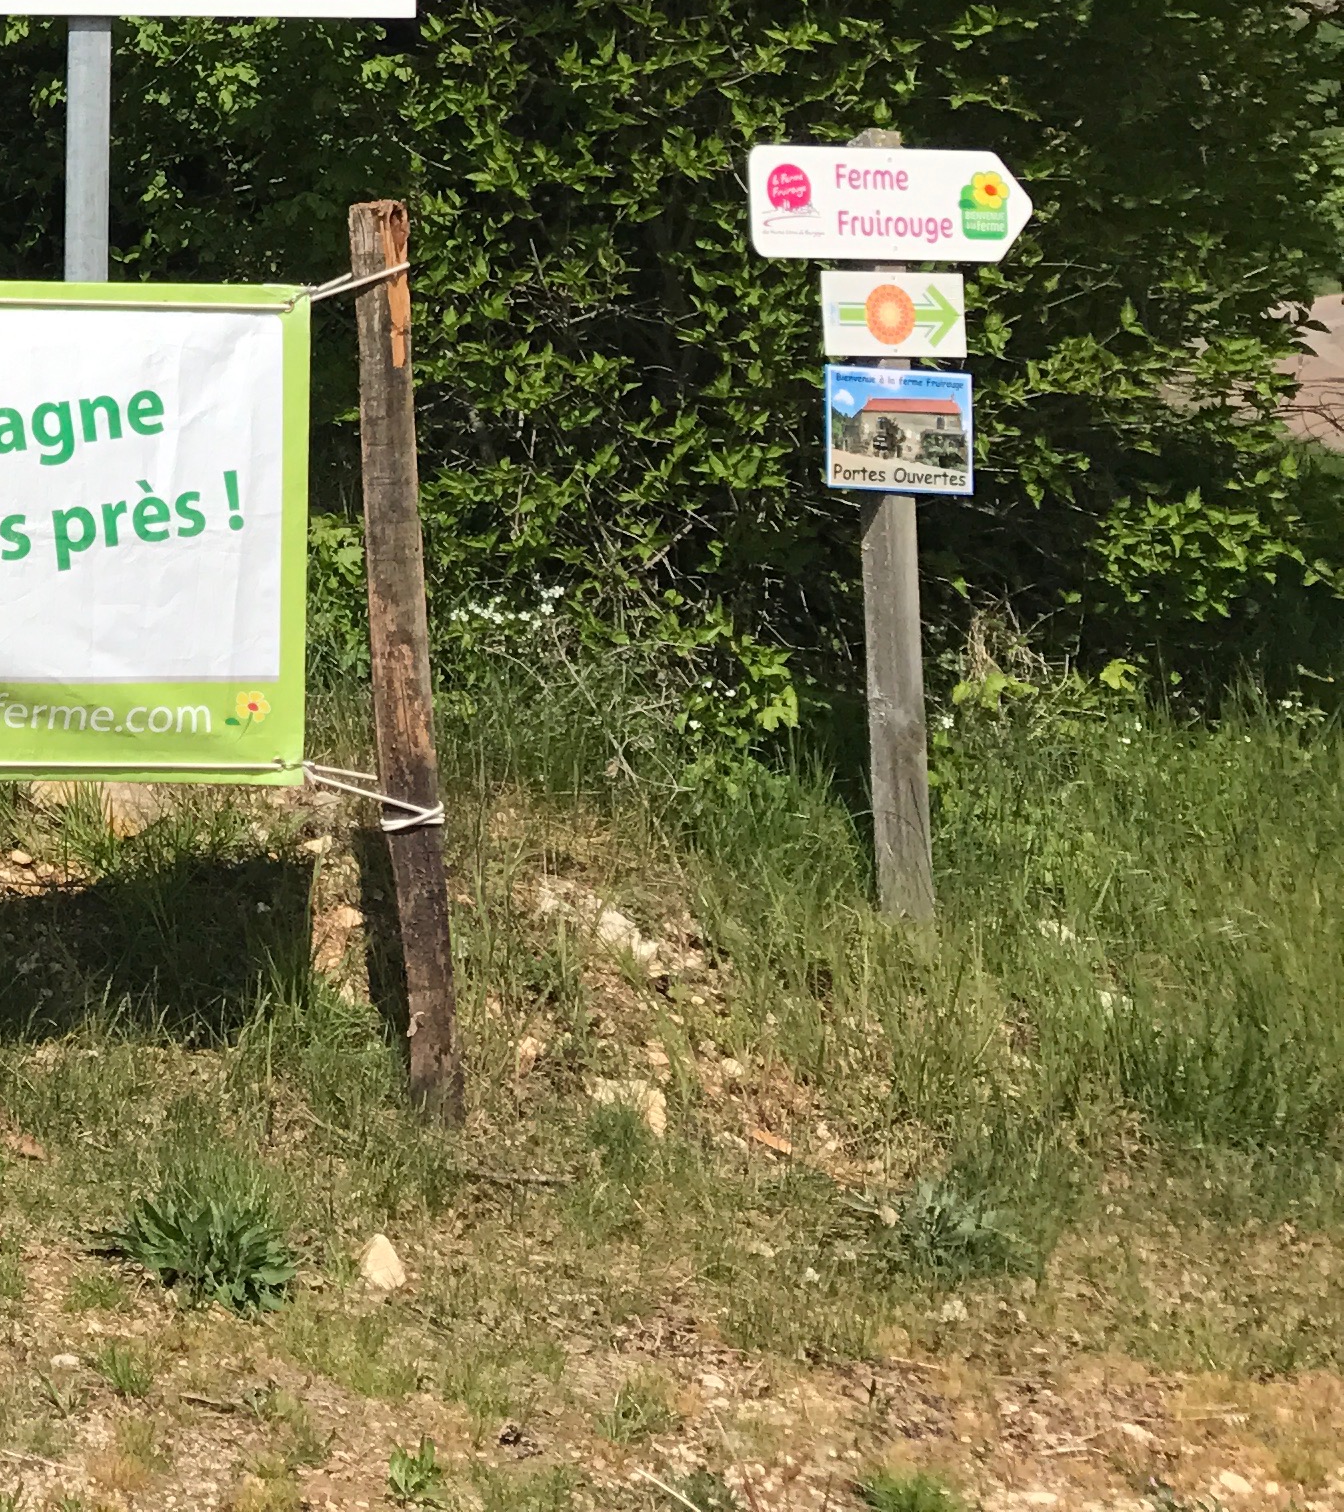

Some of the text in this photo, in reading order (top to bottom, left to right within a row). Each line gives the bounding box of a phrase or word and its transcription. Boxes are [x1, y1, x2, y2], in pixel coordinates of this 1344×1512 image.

[834, 163, 909, 192] Ferme
[837, 209, 954, 244] Fruirouge
[833, 463, 966, 486] Portes Ouvertes
[50, 479, 207, 572] près
